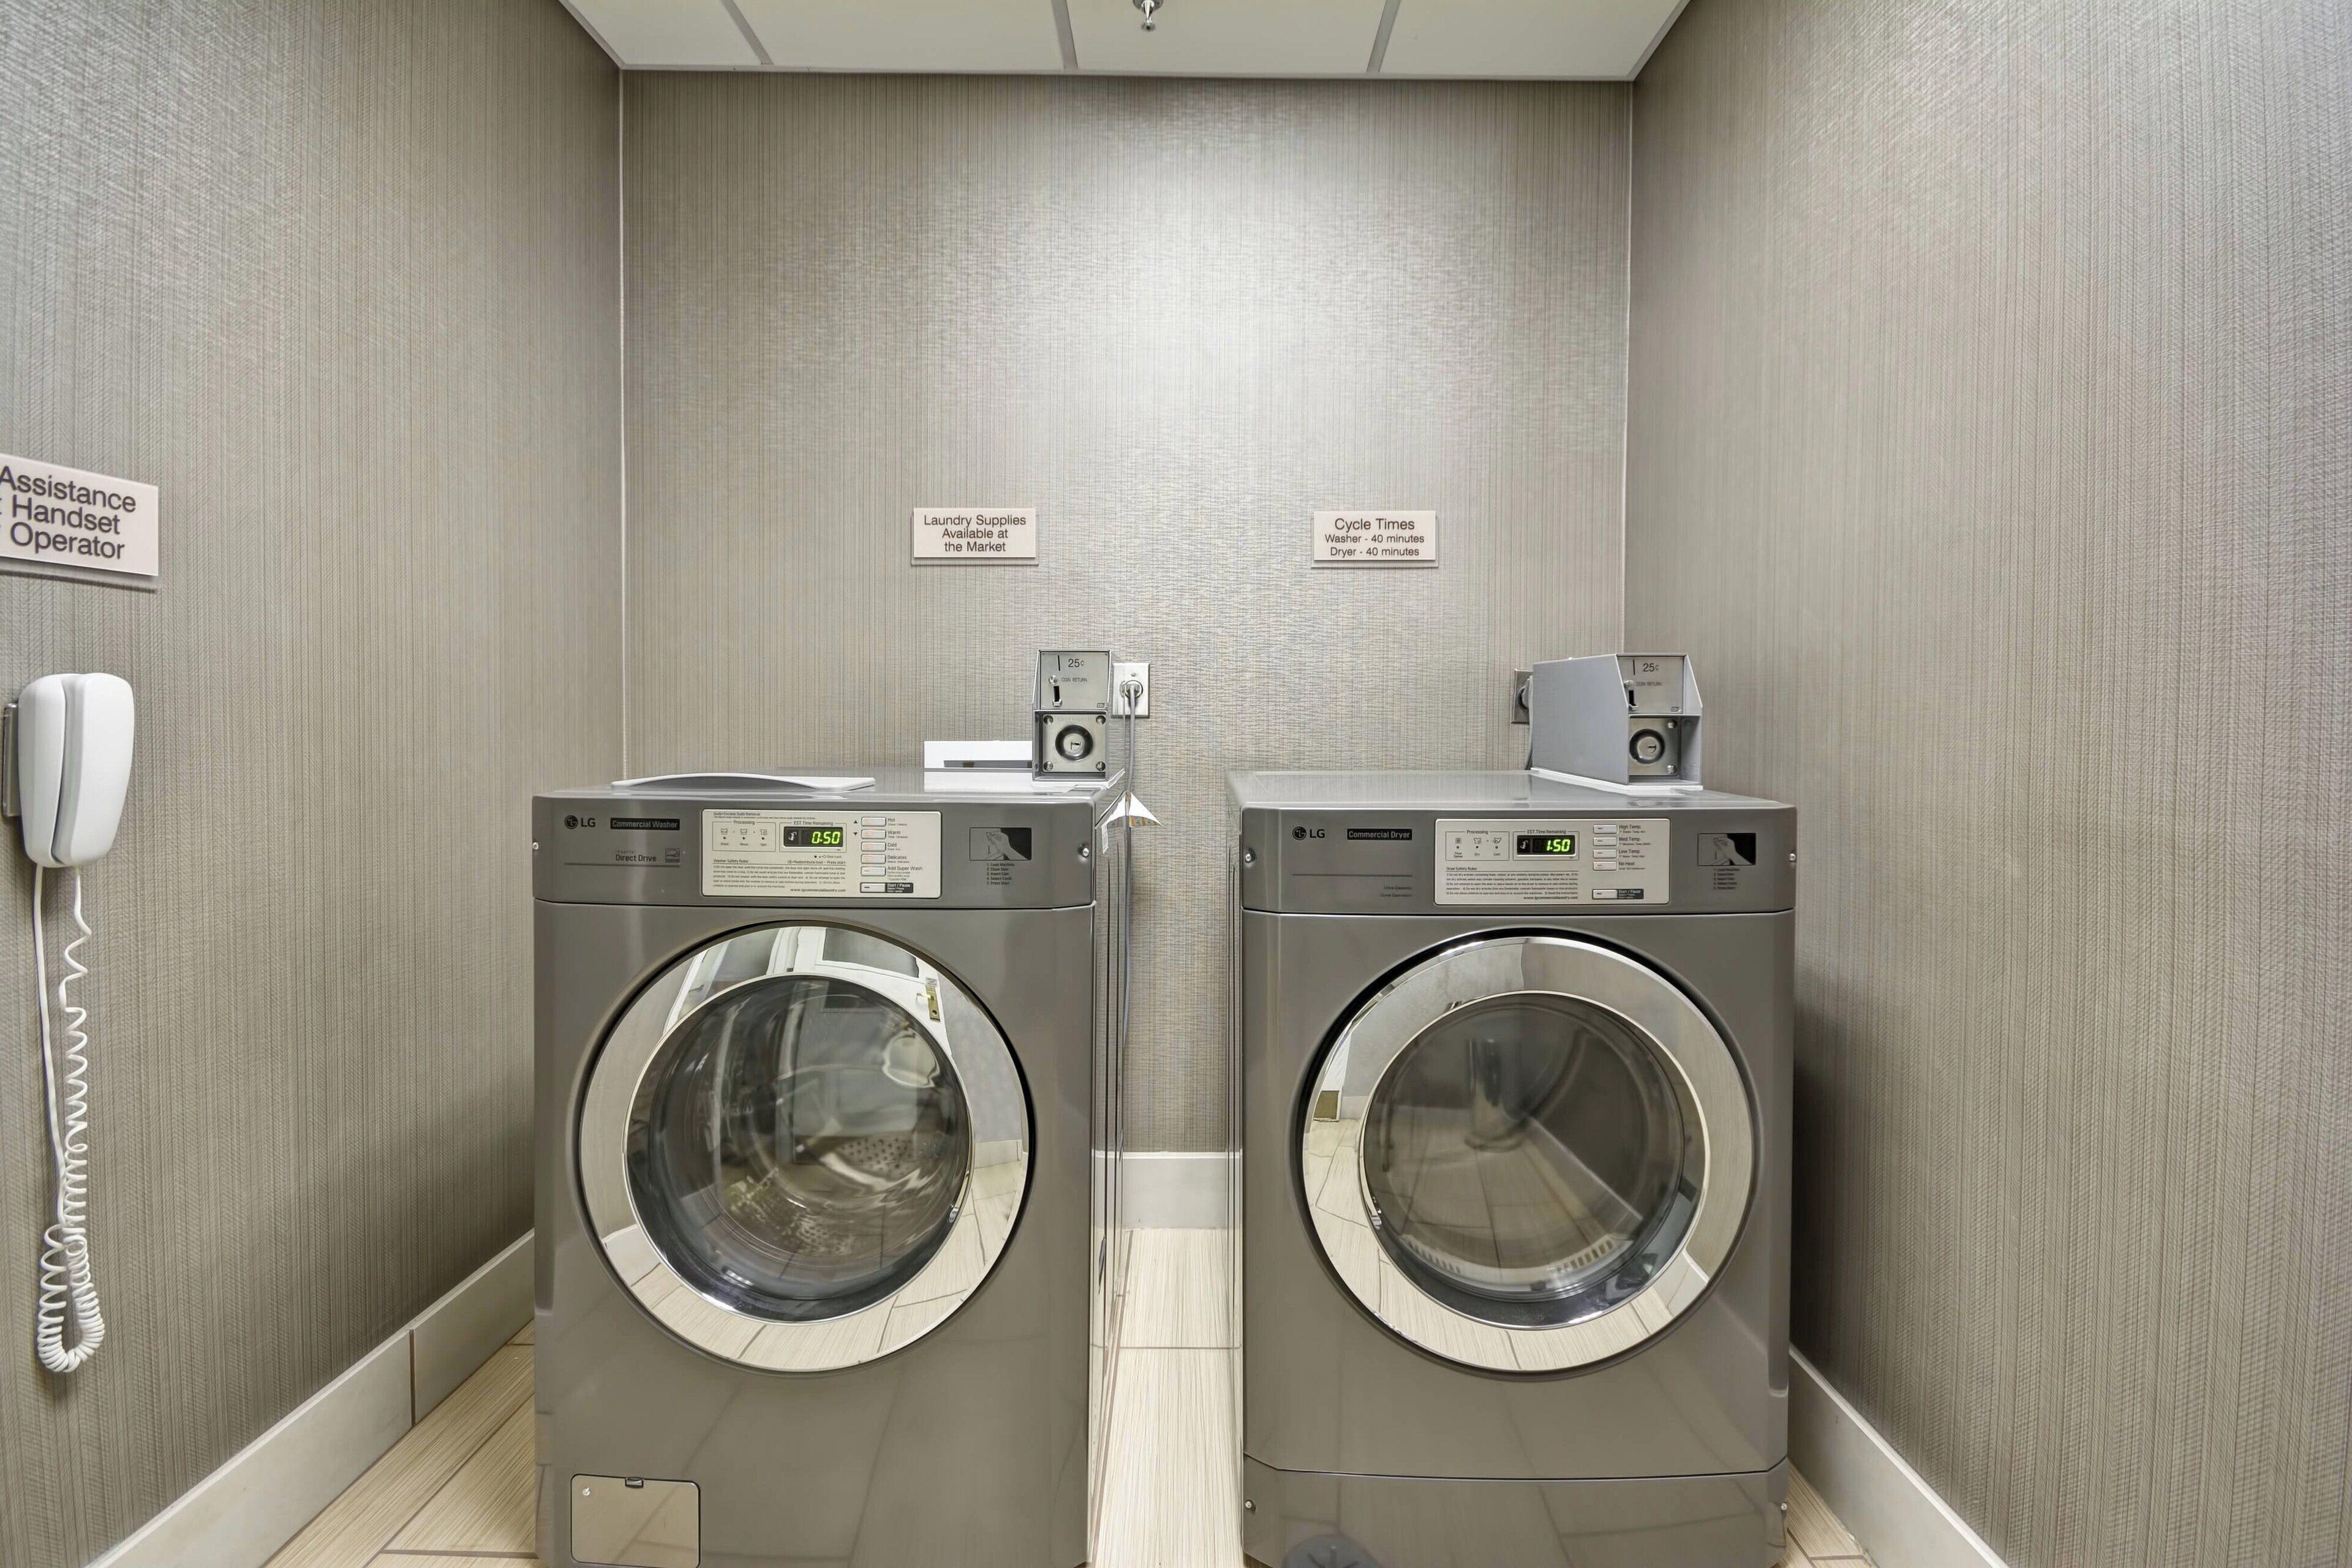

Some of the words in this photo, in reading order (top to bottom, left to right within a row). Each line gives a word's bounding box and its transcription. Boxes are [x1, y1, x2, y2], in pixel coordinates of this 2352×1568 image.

[0, 466, 136, 513] Assistance
[12, 494, 120, 534] Handset
[924, 514, 972, 528] Laundry
[976, 514, 1027, 527] Supplies
[1335, 518, 1371, 533] Cycle
[1375, 518, 1415, 530] Times
[942, 528, 993, 539] Available
[997, 529, 1008, 539] at
[1325, 534, 1362, 543] Washer
[1371, 534, 1384, 543] 40
[1387, 534, 1425, 543] minutes
[10, 522, 125, 559] Operator
[944, 541, 962, 552] the
[967, 541, 1006, 552] Market
[1330, 547, 1357, 558] Dryer
[1366, 548, 1378, 556] 40
[1381, 547, 1420, 556] minutes
[1068, 658, 1085, 668] 25¢
[1643, 663, 1659, 672] 25¢
[581, 818, 596, 827] LG
[1310, 829, 1325, 839] LG
